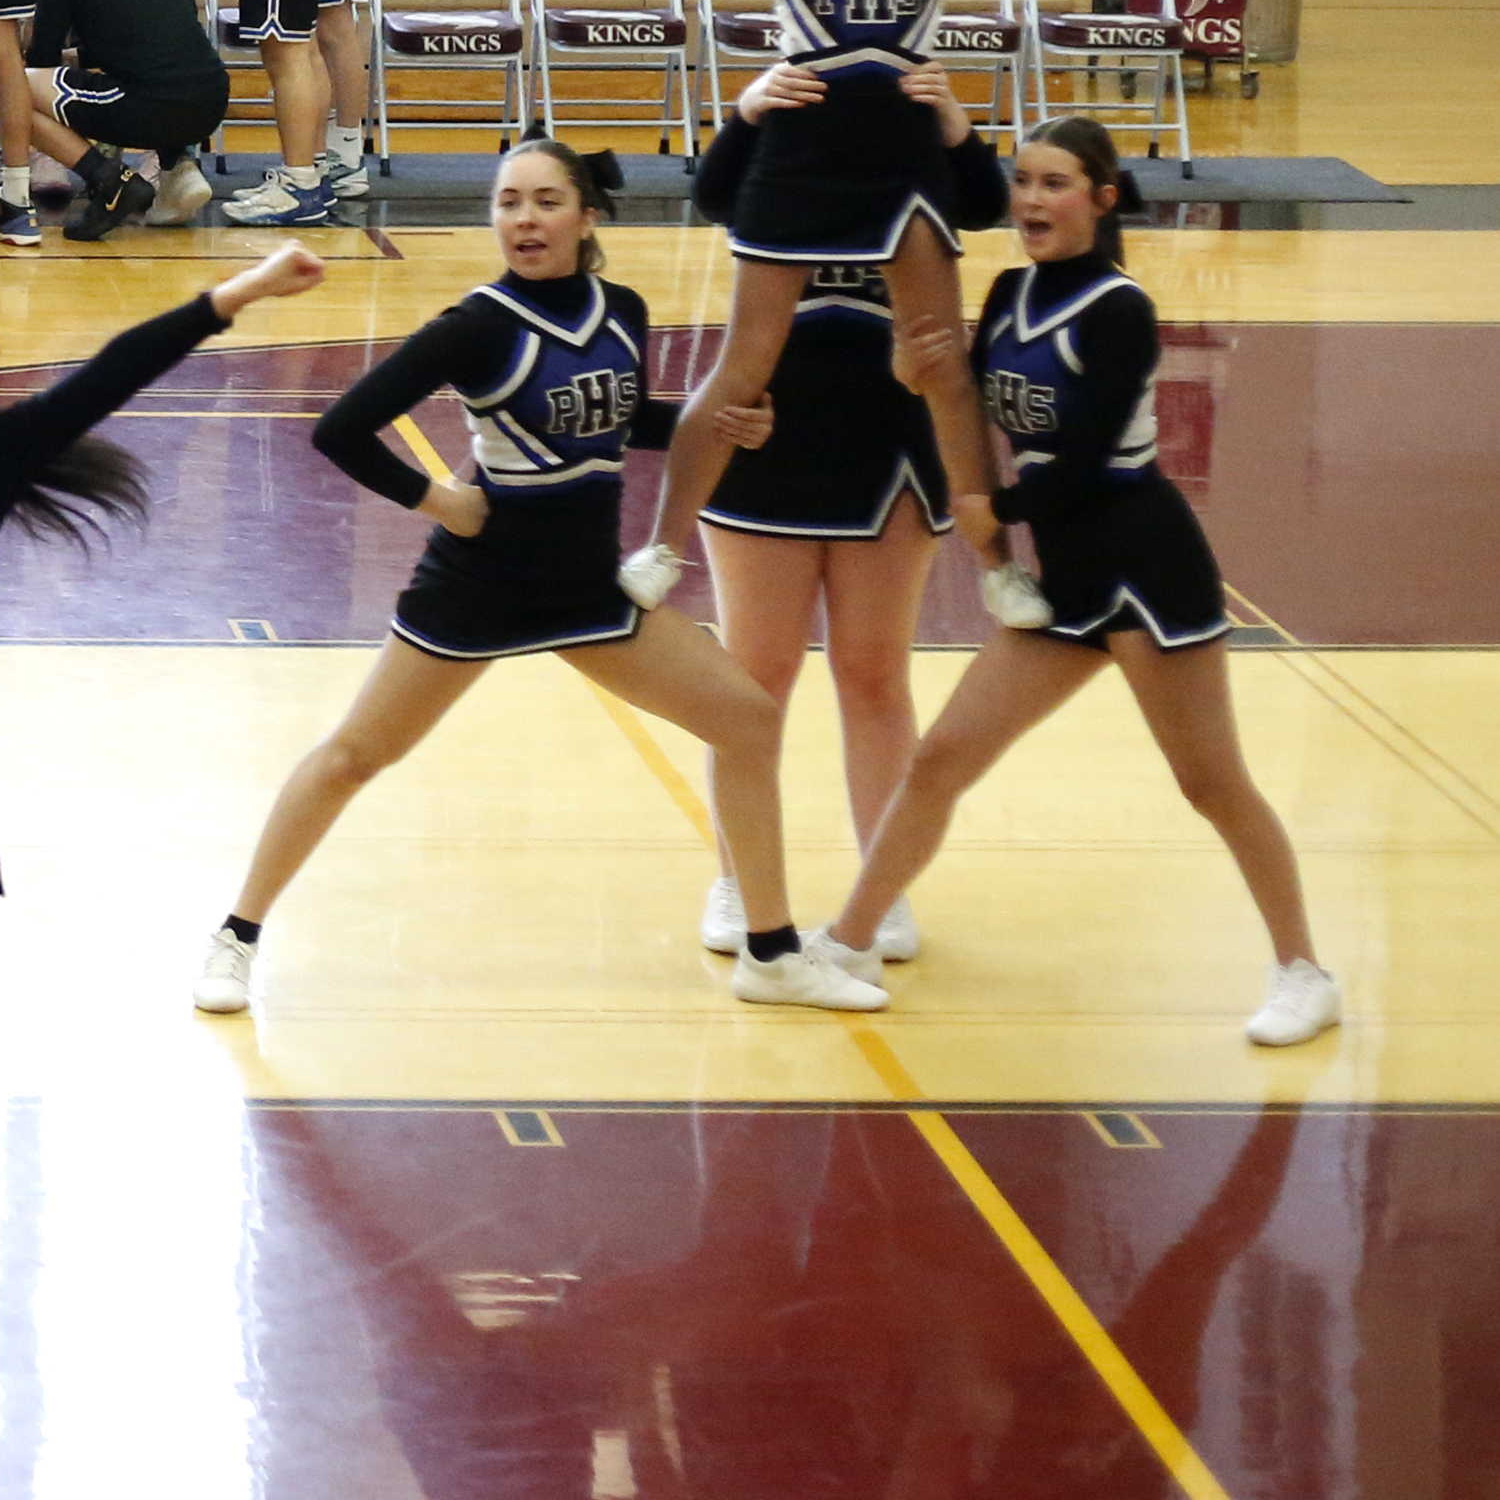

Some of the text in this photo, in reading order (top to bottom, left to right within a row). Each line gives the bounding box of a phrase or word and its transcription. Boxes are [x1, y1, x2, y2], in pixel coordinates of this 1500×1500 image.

[587, 23, 666, 43] KINGS
[1087, 26, 1167, 46] KINGS
[1181, 18, 1242, 43] NGS
[422, 33, 502, 53] KINGS
[545, 367, 641, 440] PHS
